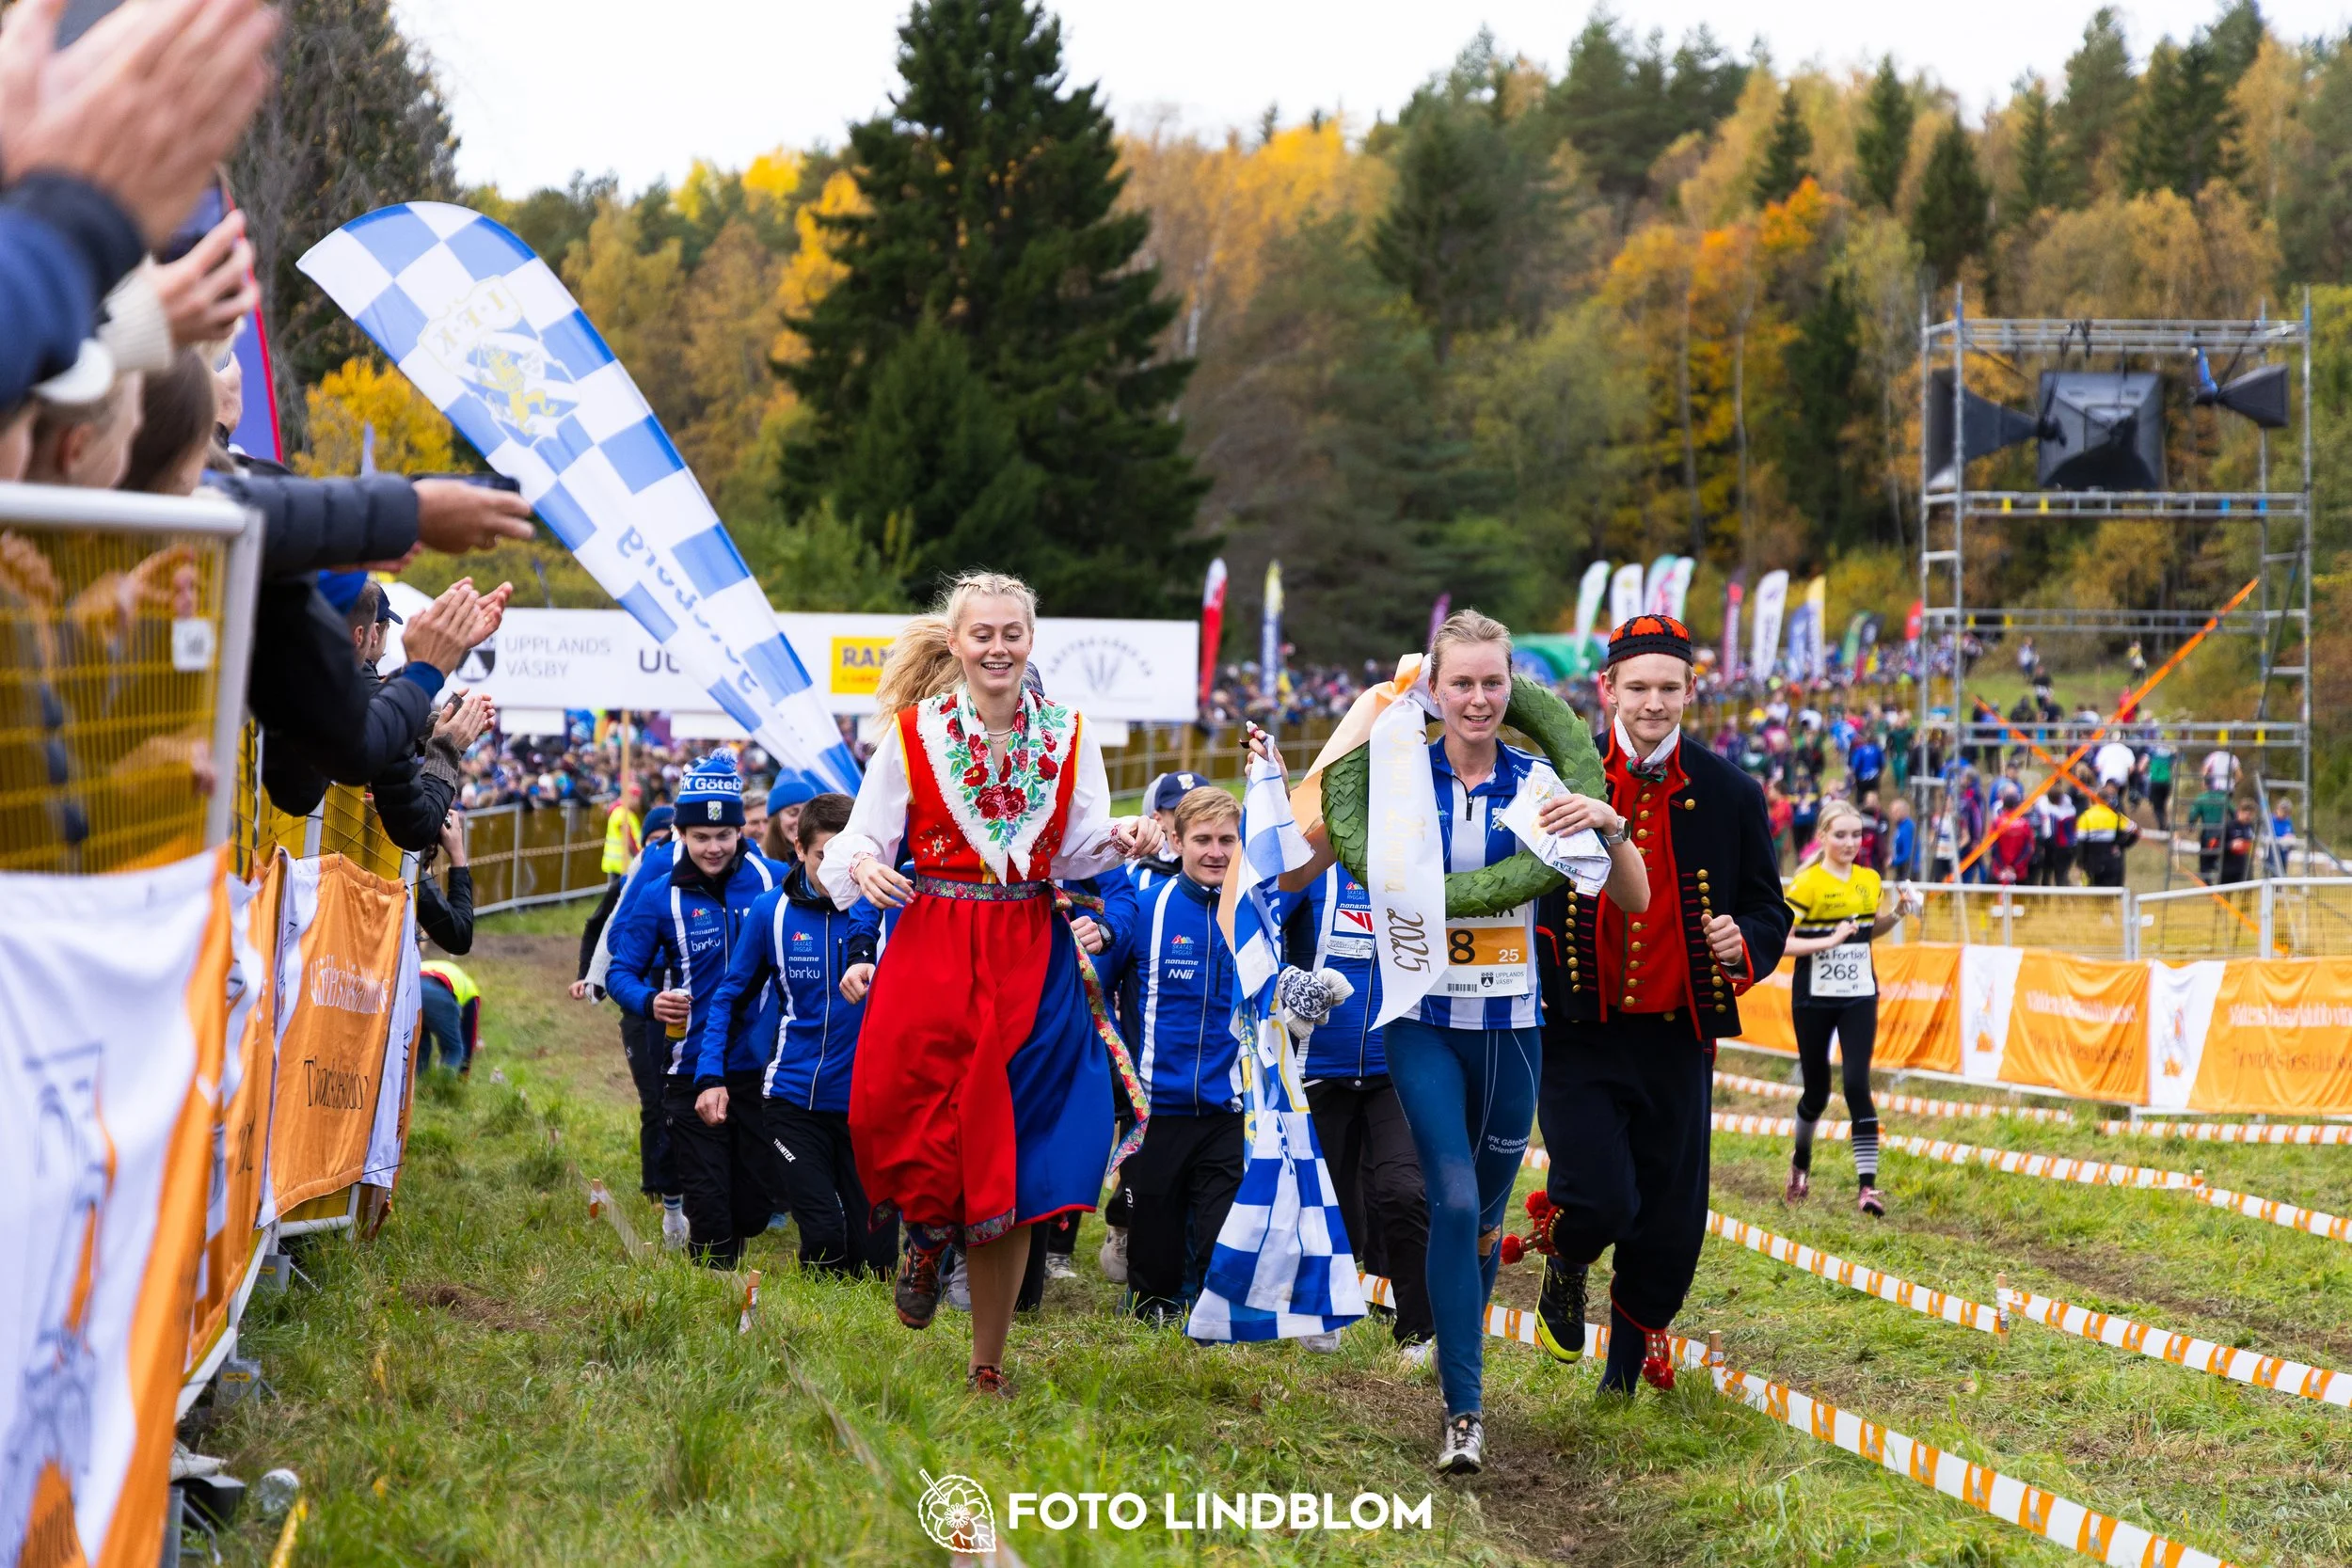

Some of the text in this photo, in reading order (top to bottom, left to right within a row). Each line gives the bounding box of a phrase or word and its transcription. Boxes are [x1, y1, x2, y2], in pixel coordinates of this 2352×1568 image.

[504, 636, 612, 655] UPPLANDS
[504, 657, 569, 678] VÄSBY
[1386, 907, 1431, 974] 2025
[1449, 929, 1476, 965] 8
[1498, 948, 1520, 963] 25
[1820, 963, 1860, 981] 268
[1487, 1134, 1501, 1145] IFK
[773, 1138, 796, 1163] TRIMTEX
